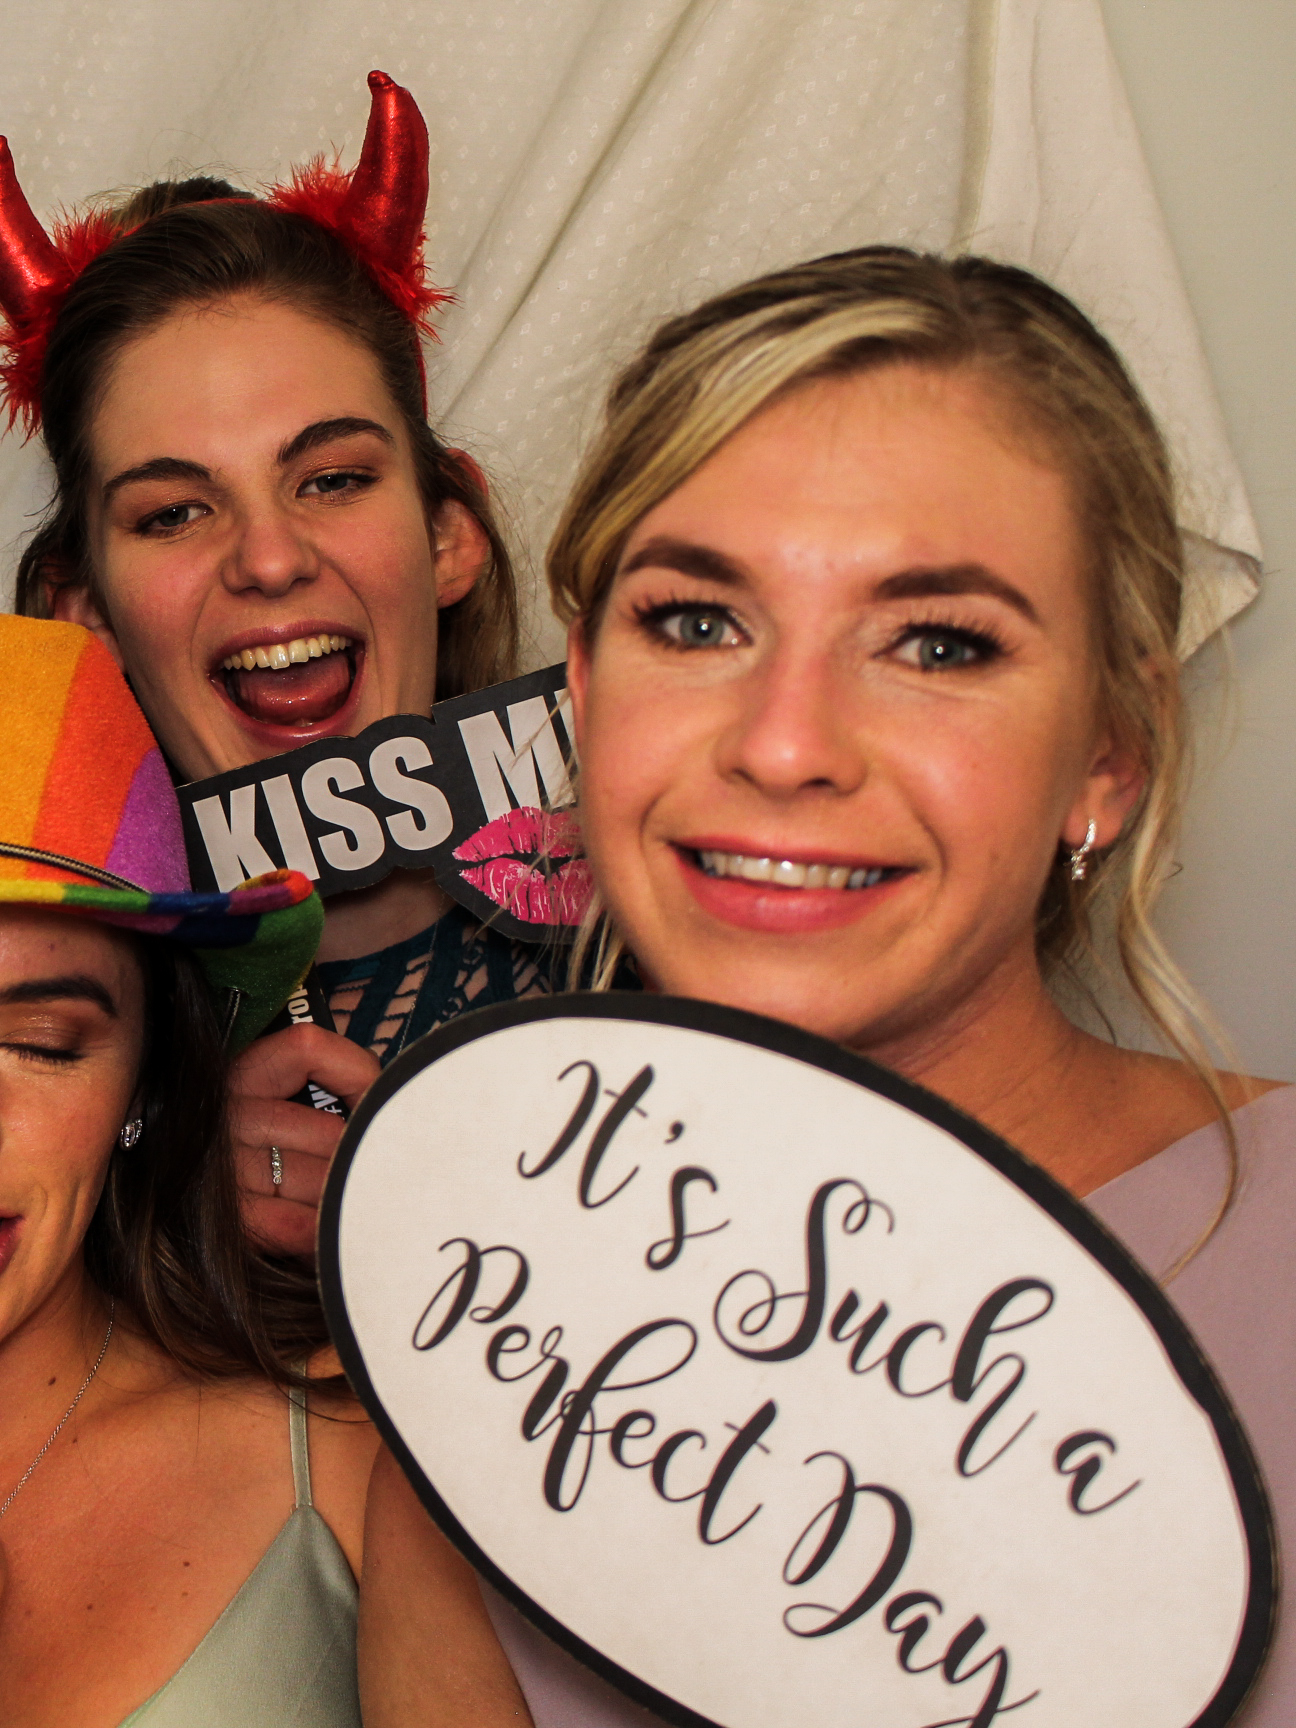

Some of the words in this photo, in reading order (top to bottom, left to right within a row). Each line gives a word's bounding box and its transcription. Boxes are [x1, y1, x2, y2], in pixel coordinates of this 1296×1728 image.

[191, 735, 454, 893] KISS
[457, 686, 577, 824] M
[411, 1237, 778, 1546] Perfect
[782, 1450, 1042, 1728] Day
[517, 1060, 731, 1272] It's
[713, 1178, 1056, 1479] Such
[1053, 1429, 1142, 1516] a
